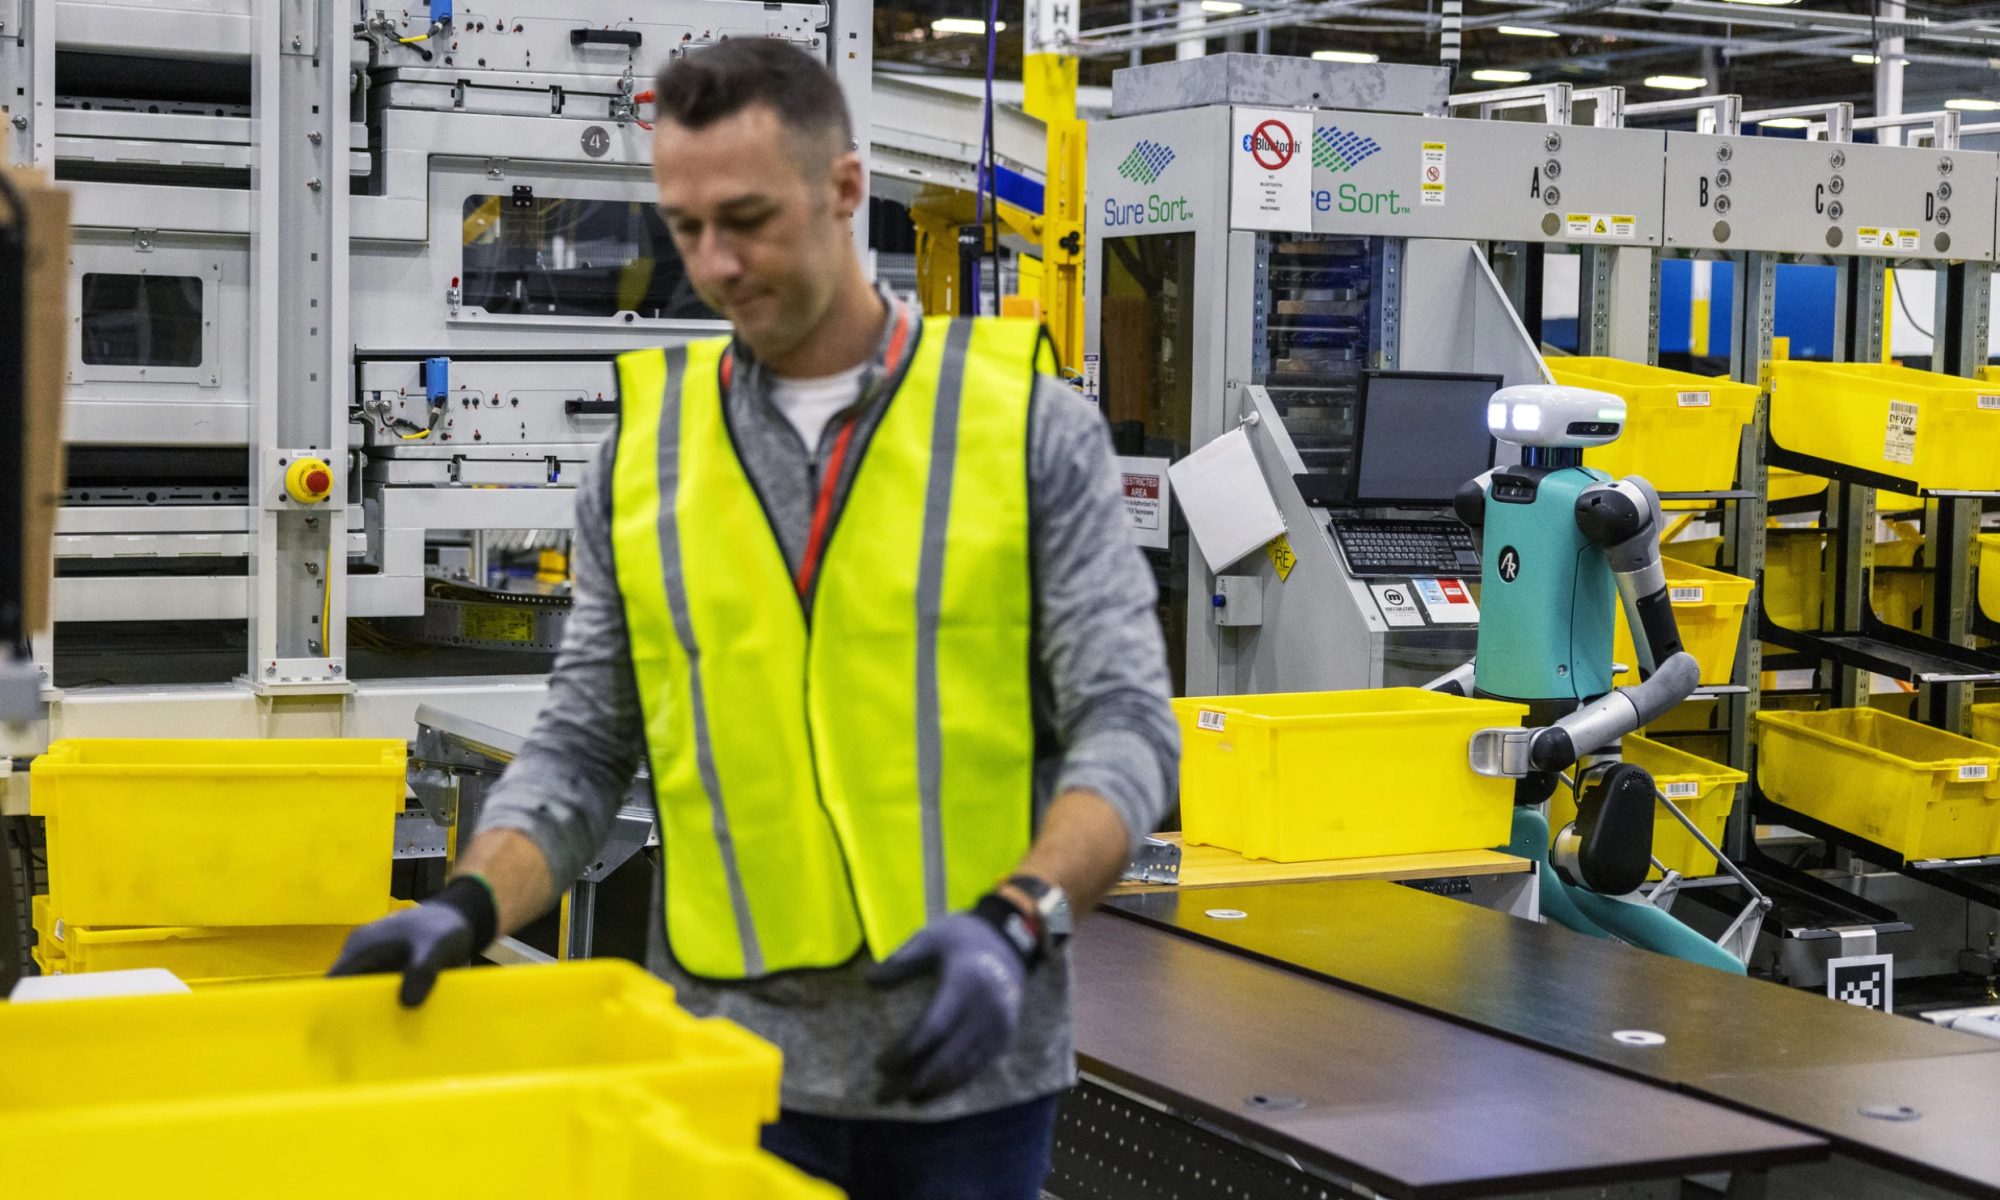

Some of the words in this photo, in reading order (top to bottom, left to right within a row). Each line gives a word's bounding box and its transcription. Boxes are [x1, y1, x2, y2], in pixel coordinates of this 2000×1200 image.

[589, 133, 601, 149] 4
[1530, 165, 1540, 199] A
[1699, 176, 1709, 208] B
[1104, 197, 1144, 226] Sure
[1814, 182, 1824, 215] C
[1925, 191, 1934, 222] D
[1889, 413, 1914, 425] DFW7
[1130, 487, 1148, 498] AREA
